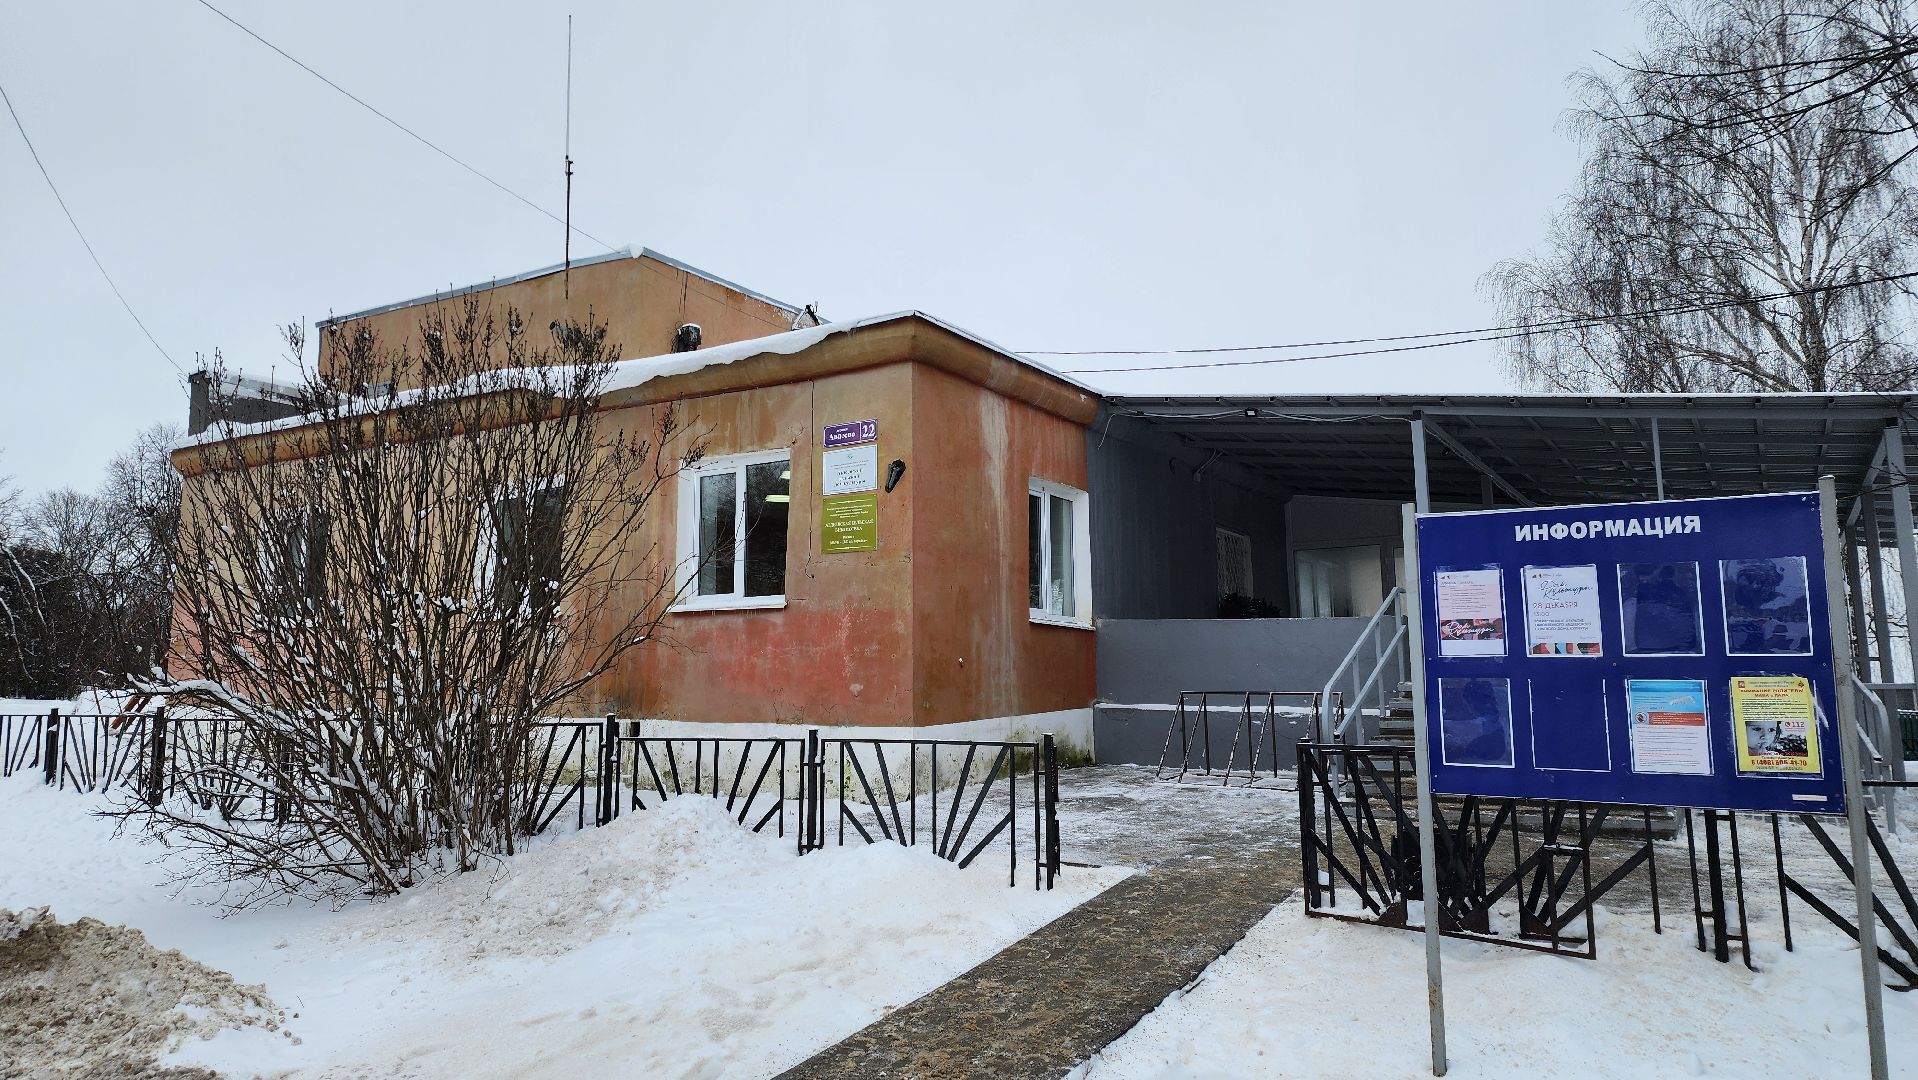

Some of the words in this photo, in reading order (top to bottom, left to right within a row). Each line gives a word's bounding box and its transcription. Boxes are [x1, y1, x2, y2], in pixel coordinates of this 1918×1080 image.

[861, 423, 876, 438] 22
[1515, 515, 1701, 541] ИНФОРМАЦИЯ
[1545, 601, 1578, 610] ДЕКАБРЯ
